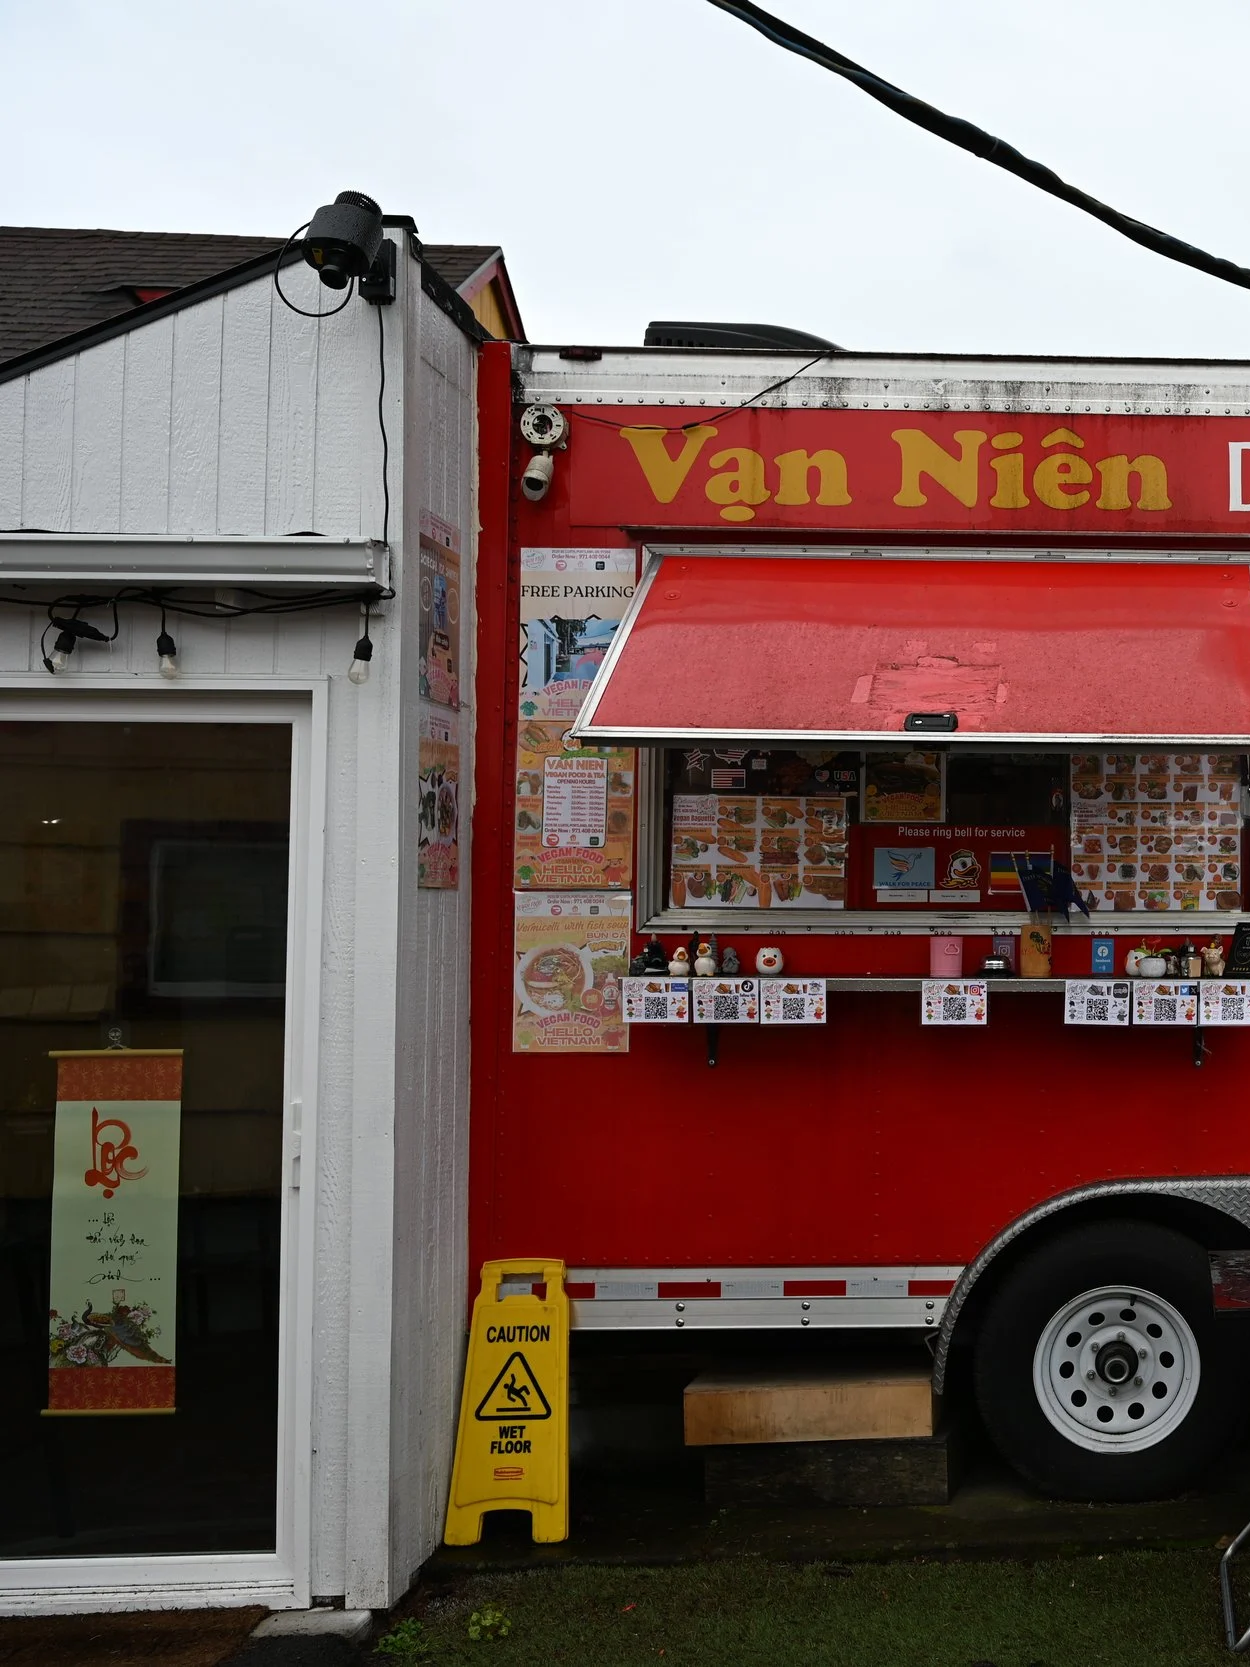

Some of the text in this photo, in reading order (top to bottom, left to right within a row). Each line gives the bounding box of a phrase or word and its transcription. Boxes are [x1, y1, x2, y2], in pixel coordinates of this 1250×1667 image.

[620, 424, 853, 522] Vạn
[892, 427, 1172, 511] Niên
[521, 585, 634, 598] FREE PARKING
[542, 680, 578, 696] VEGAN
[548, 698, 582, 707] HEL
[547, 760, 604, 771] VAN NIEN
[834, 770, 857, 782] USA
[898, 826, 1026, 840] Please ring bell for service
[537, 848, 572, 863] VEGAN
[575, 848, 604, 863] FOOD
[543, 865, 594, 875] HELLO
[535, 874, 600, 883] VIETNAM
[516, 919, 629, 932] Vermicelli with fish soup
[536, 1013, 600, 1029] VEGAN FOOD
[544, 1028, 593, 1037] HELLO
[537, 1037, 600, 1046] VIETNAM
[486, 1325, 550, 1343] CAUTION
[499, 1426, 526, 1439] WET
[490, 1440, 531, 1455] FLOOR
